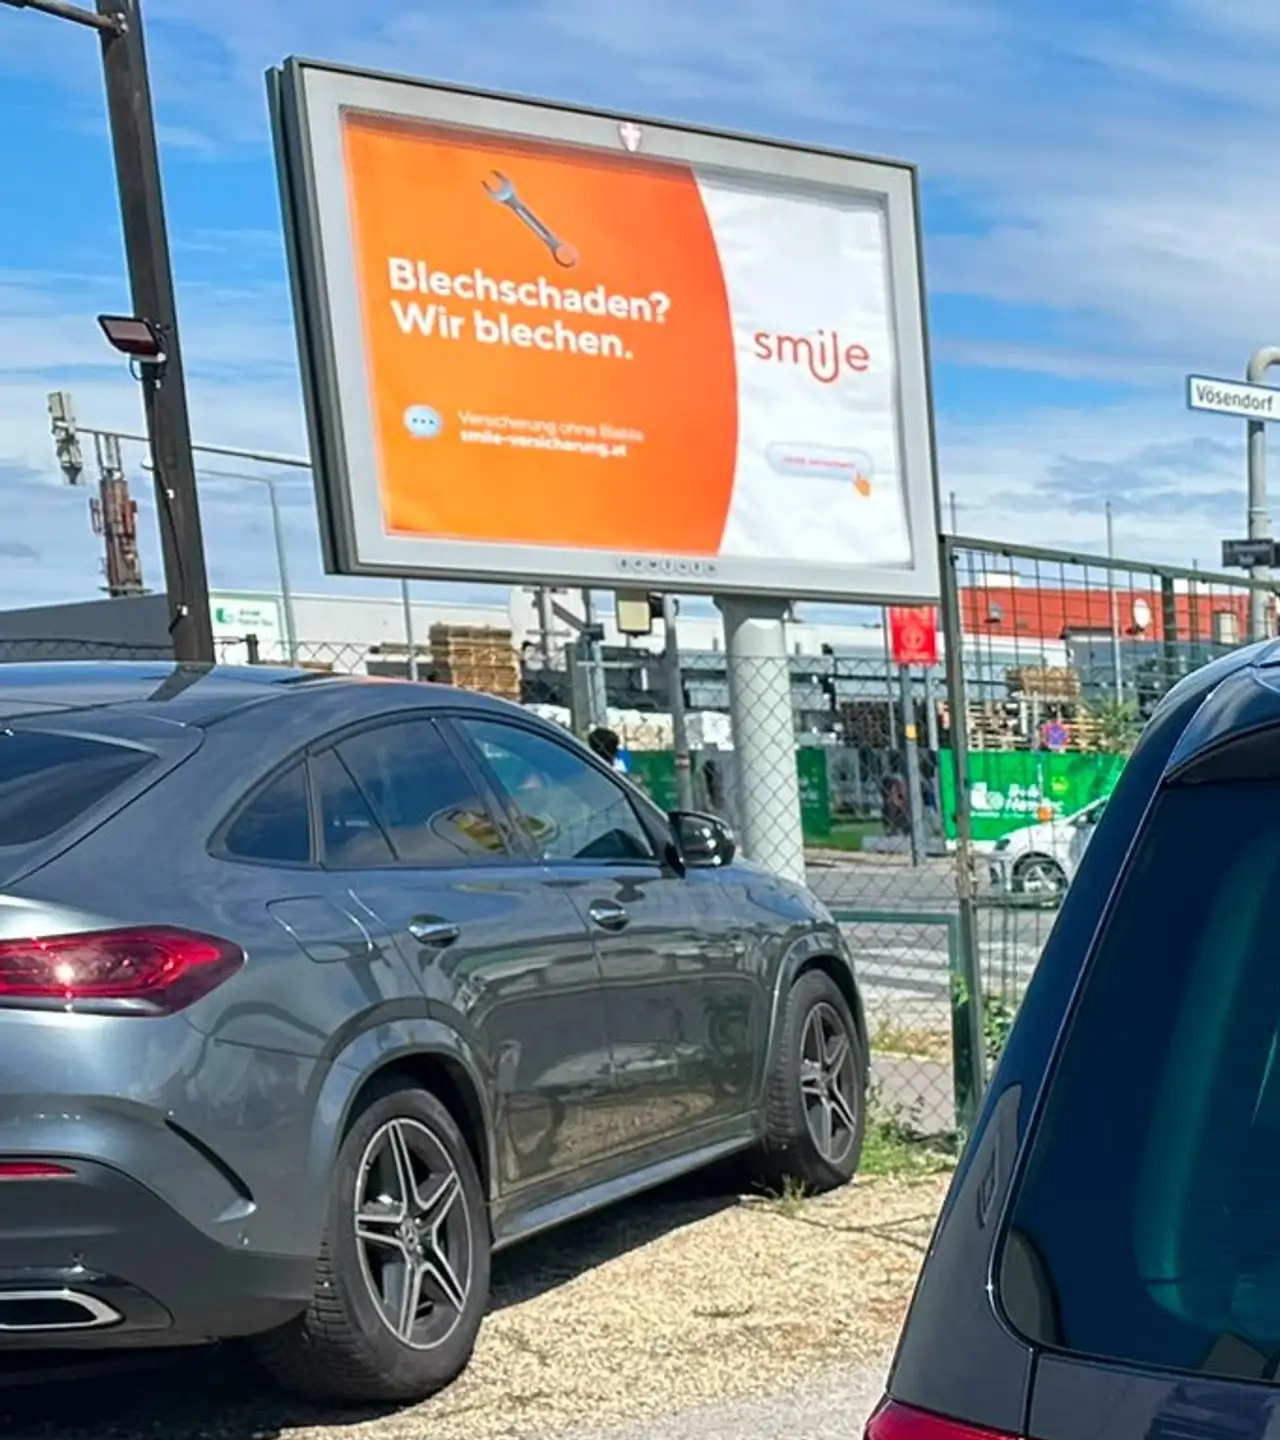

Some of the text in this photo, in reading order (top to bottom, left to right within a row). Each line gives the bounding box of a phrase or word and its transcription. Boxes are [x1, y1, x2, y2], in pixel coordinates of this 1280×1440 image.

[388, 256, 671, 324] Blechschaden?
[390, 299, 634, 360] Wir blechen.
[754, 329, 870, 383] smile
[1196, 383, 1273, 412] Vösendorf
